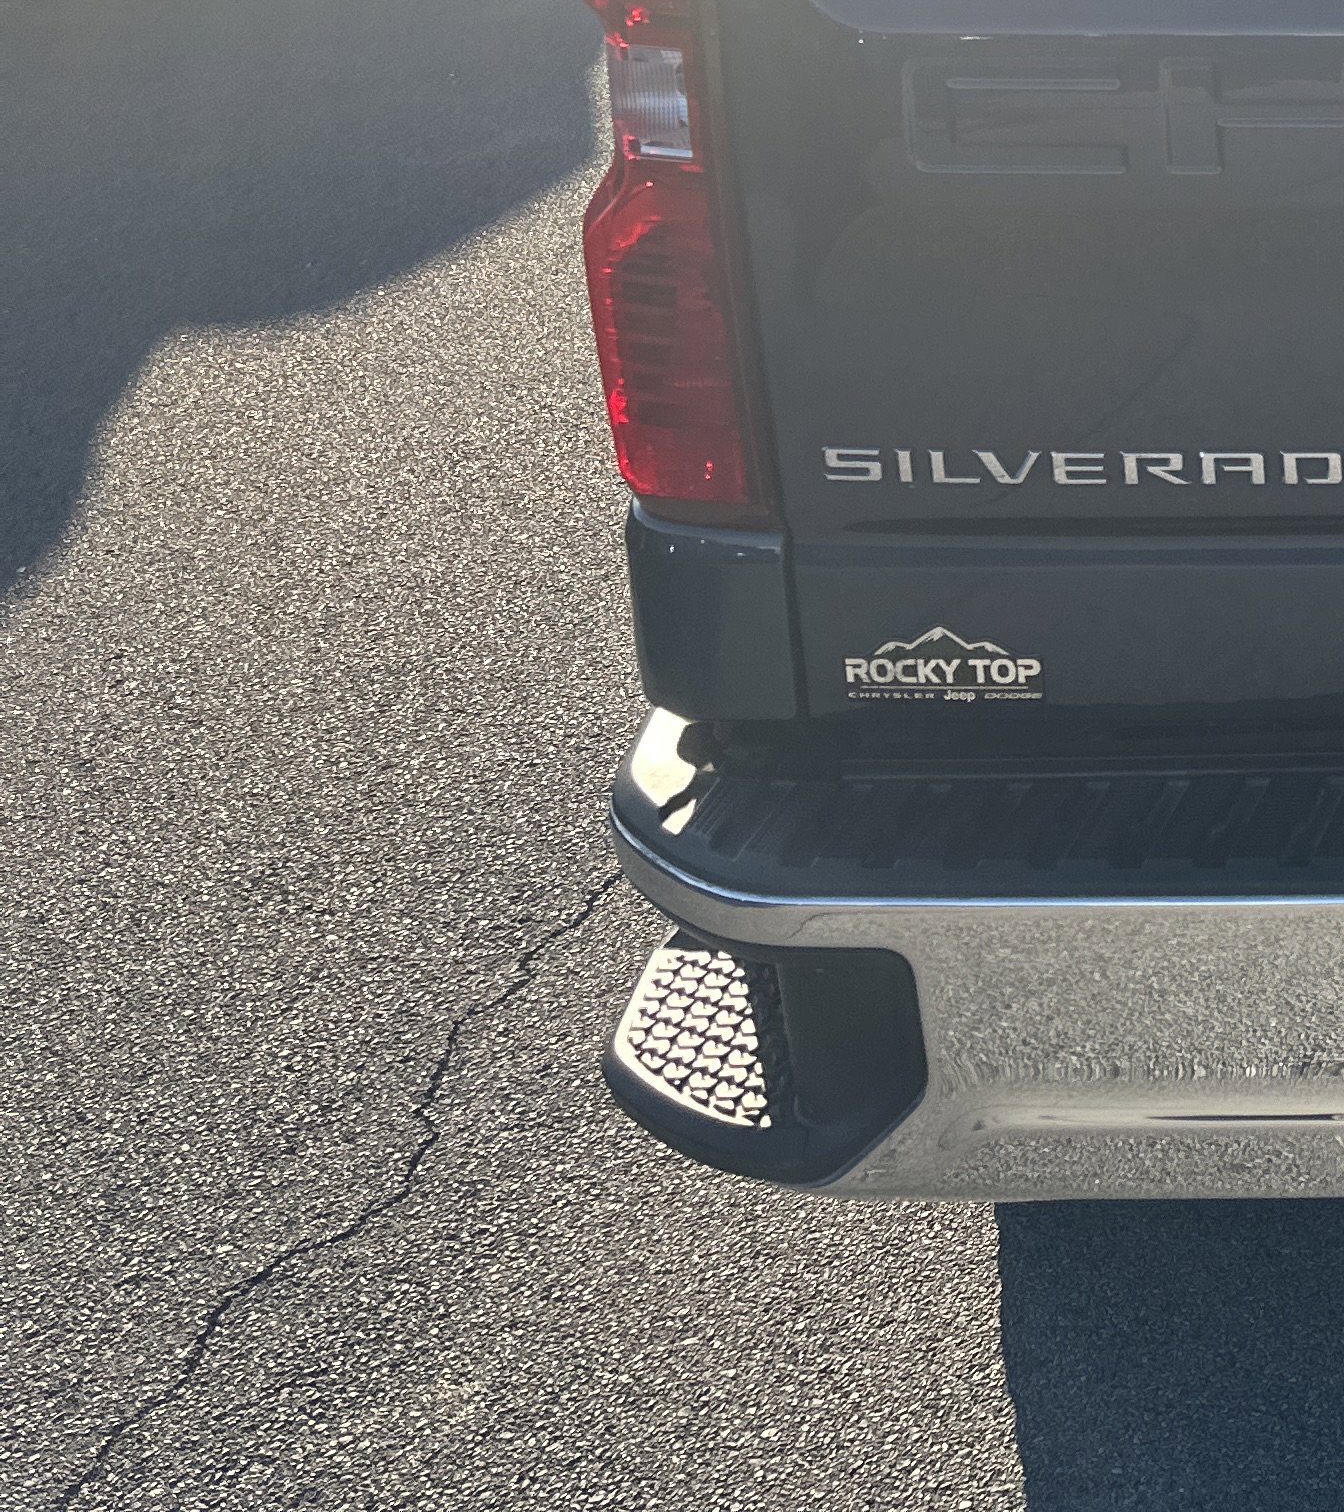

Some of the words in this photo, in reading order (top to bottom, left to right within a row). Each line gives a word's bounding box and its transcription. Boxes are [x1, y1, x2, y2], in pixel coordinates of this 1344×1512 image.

[844, 657, 961, 684] ROCKY
[967, 658, 1042, 684] TOP
[848, 691, 935, 699] CHRYSLER
[943, 689, 977, 703] Jeep
[984, 691, 1043, 699] DODGE
